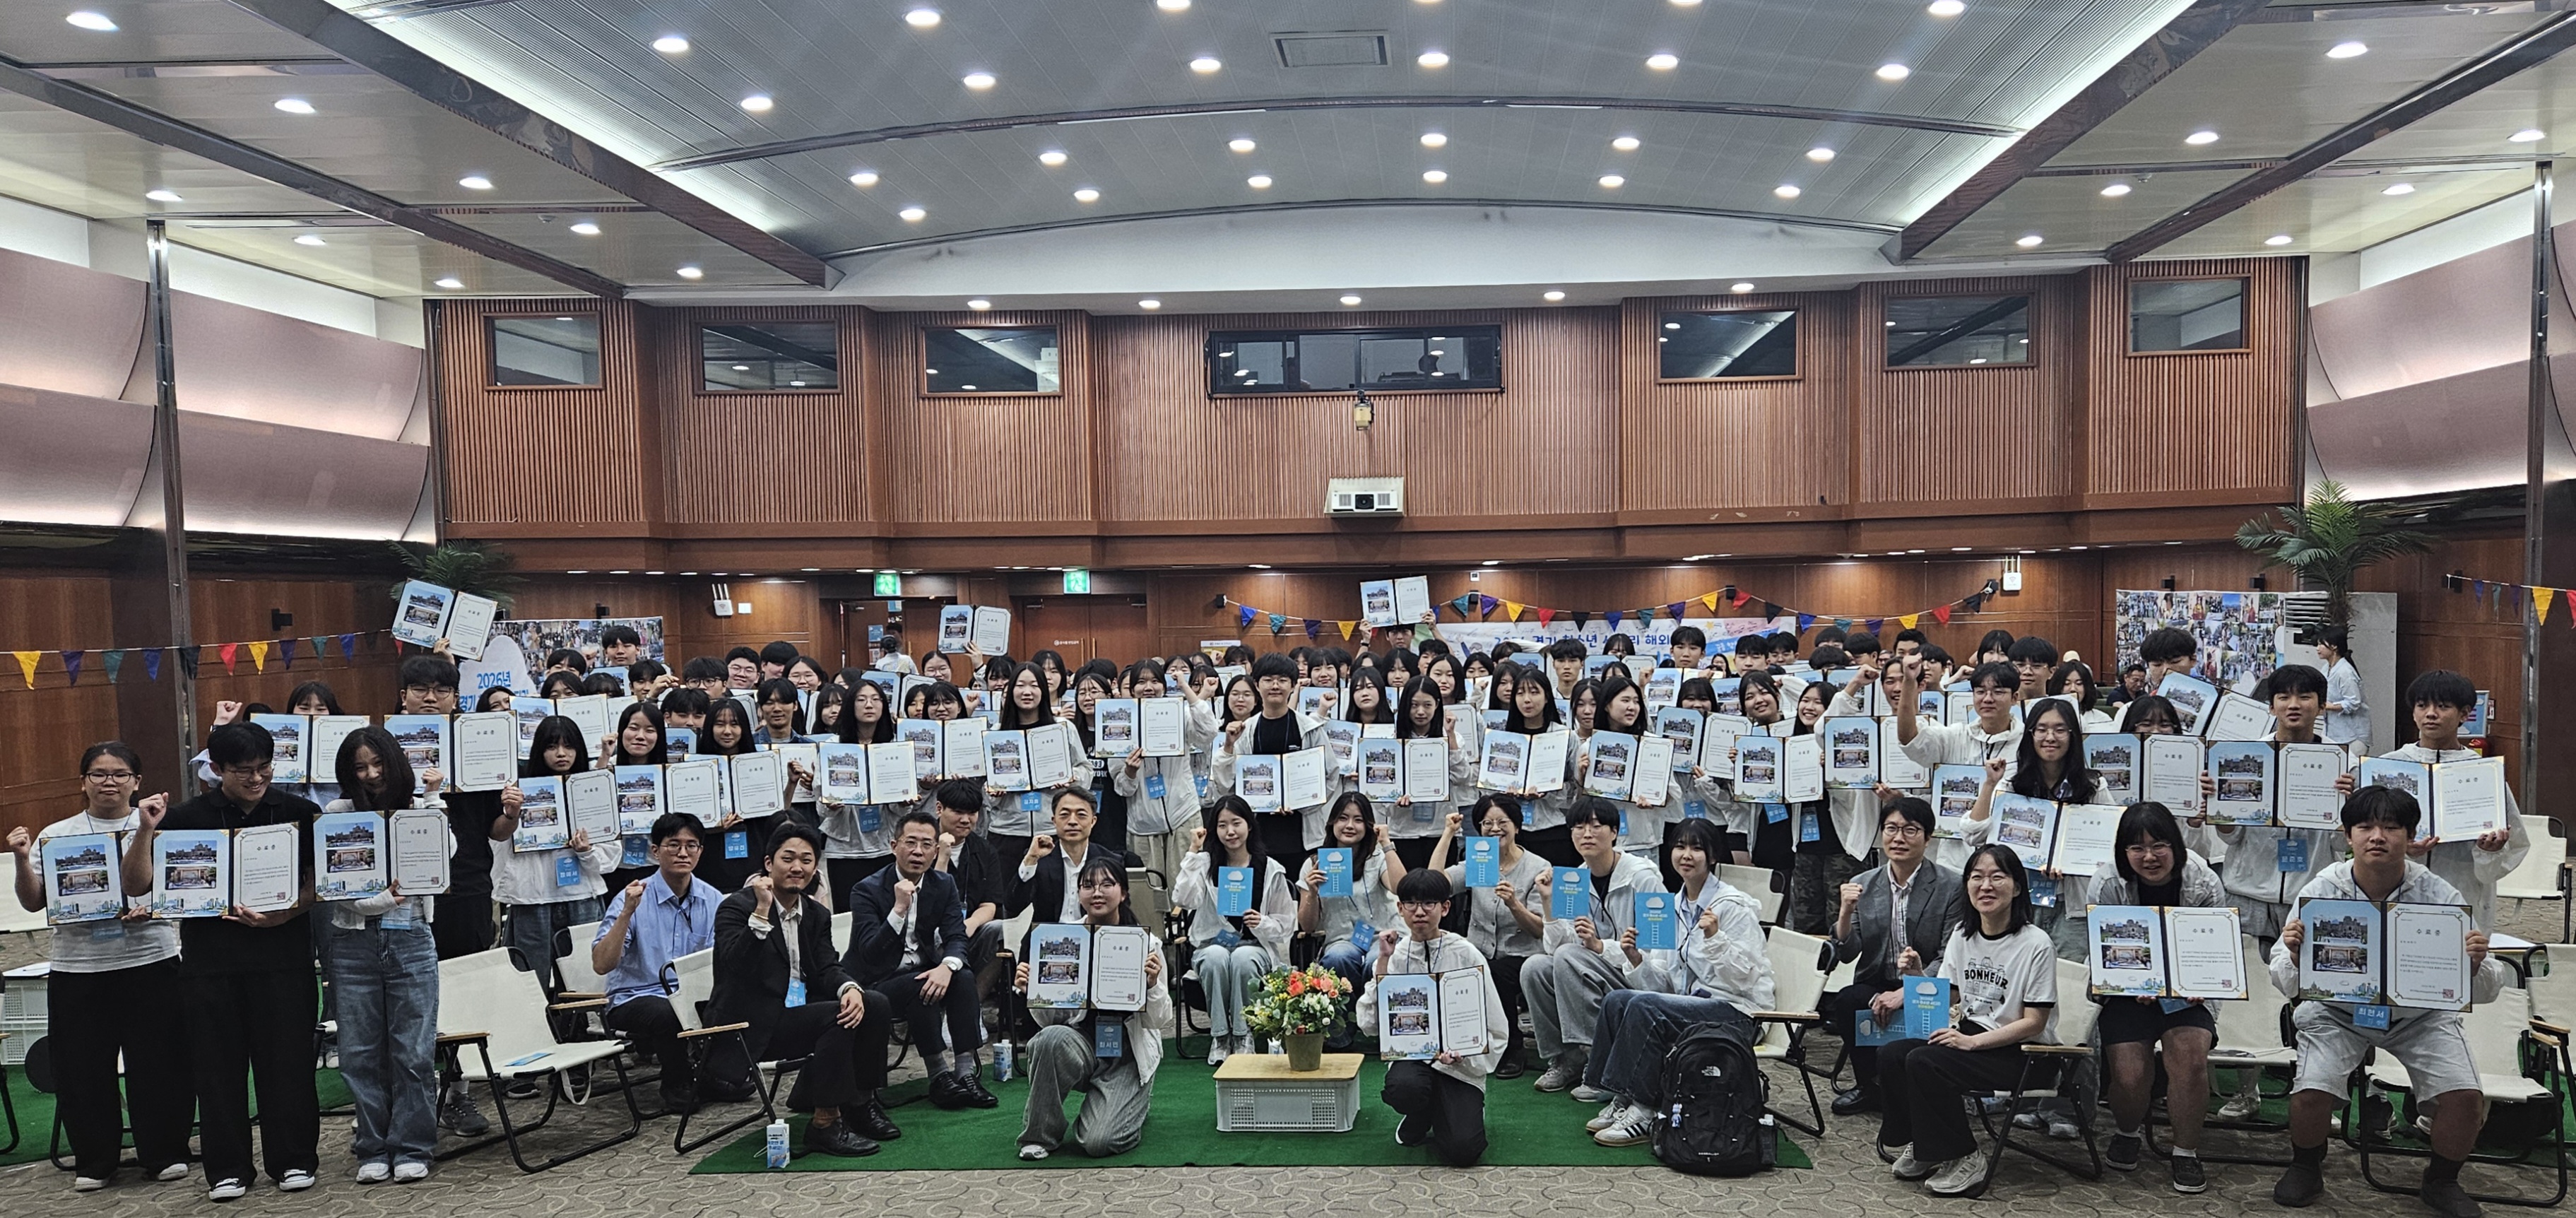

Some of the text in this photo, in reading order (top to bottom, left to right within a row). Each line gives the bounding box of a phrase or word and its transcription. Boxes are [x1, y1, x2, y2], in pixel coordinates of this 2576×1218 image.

[1645, 634, 1670, 646] 해외
[477, 670, 511, 689] 2026년
[1964, 969, 2009, 990] BONHEUR
